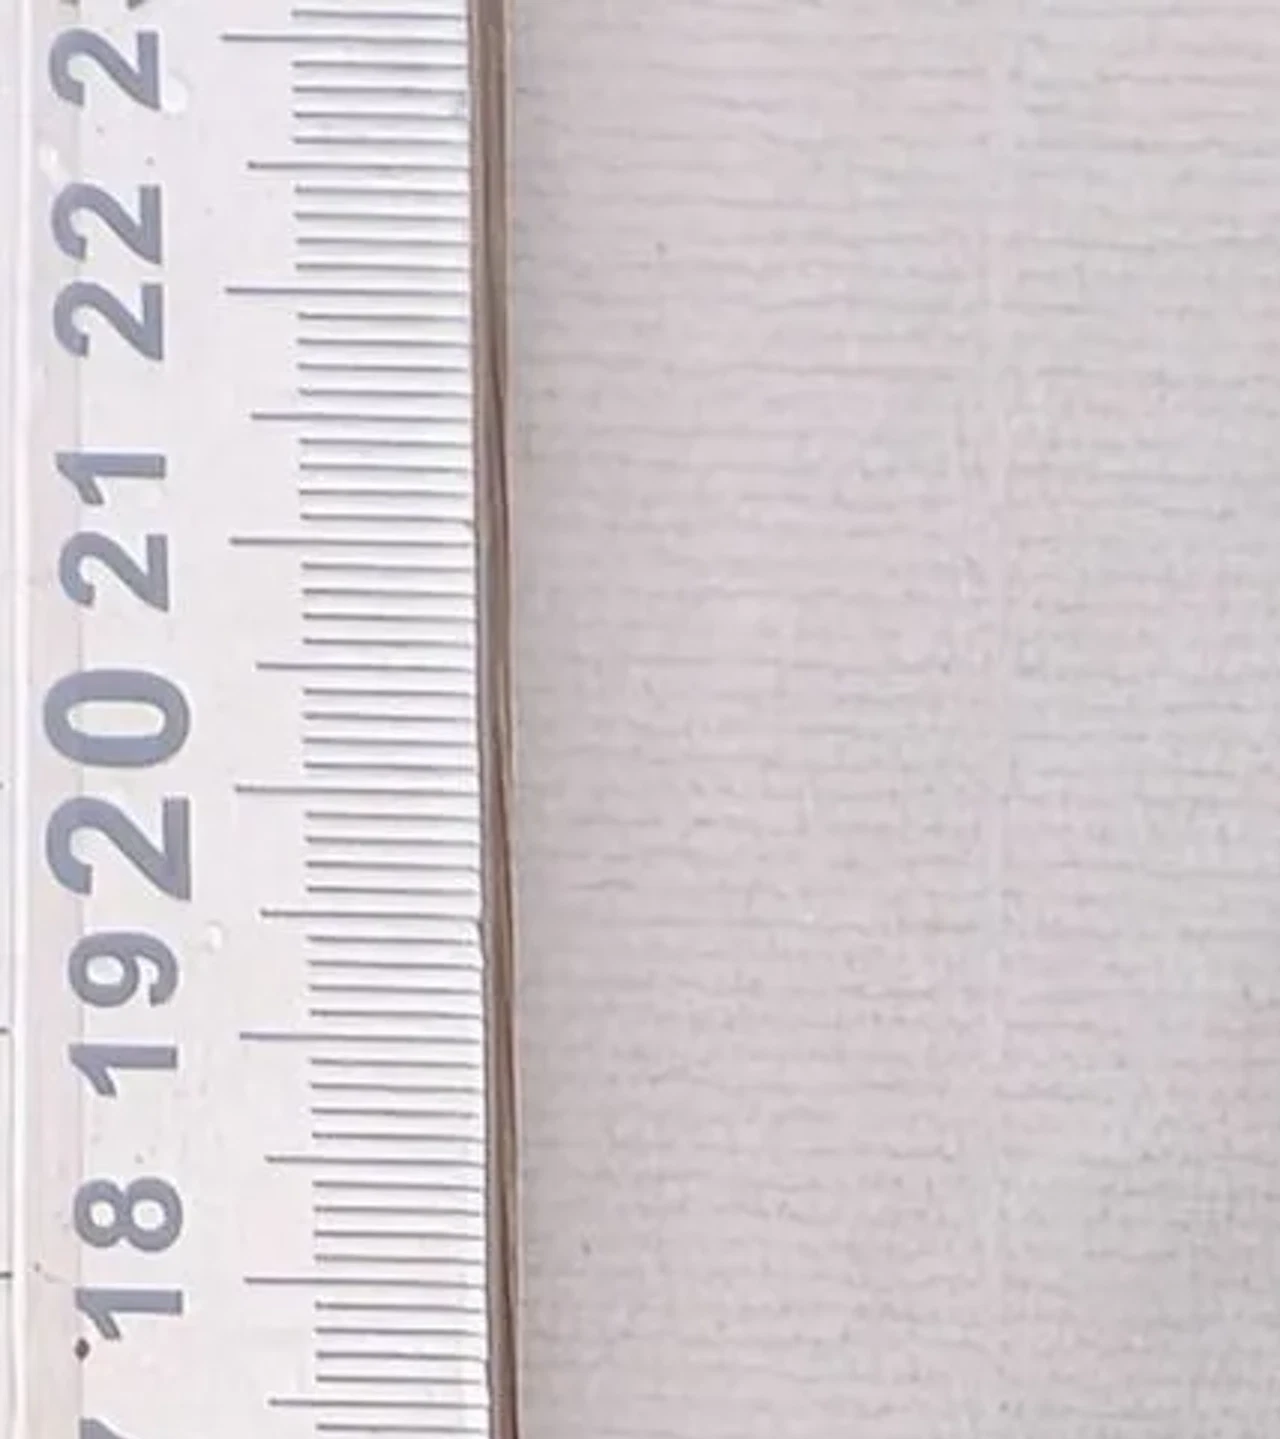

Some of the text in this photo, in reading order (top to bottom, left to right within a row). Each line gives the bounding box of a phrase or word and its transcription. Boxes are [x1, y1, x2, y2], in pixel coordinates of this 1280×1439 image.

[48, 0, 161, 112] 2
[50, 182, 164, 362] 22
[54, 451, 169, 613] 21
[43, 668, 192, 903] 20
[67, 932, 179, 1099] 19
[71, 1177, 183, 1342] 18
